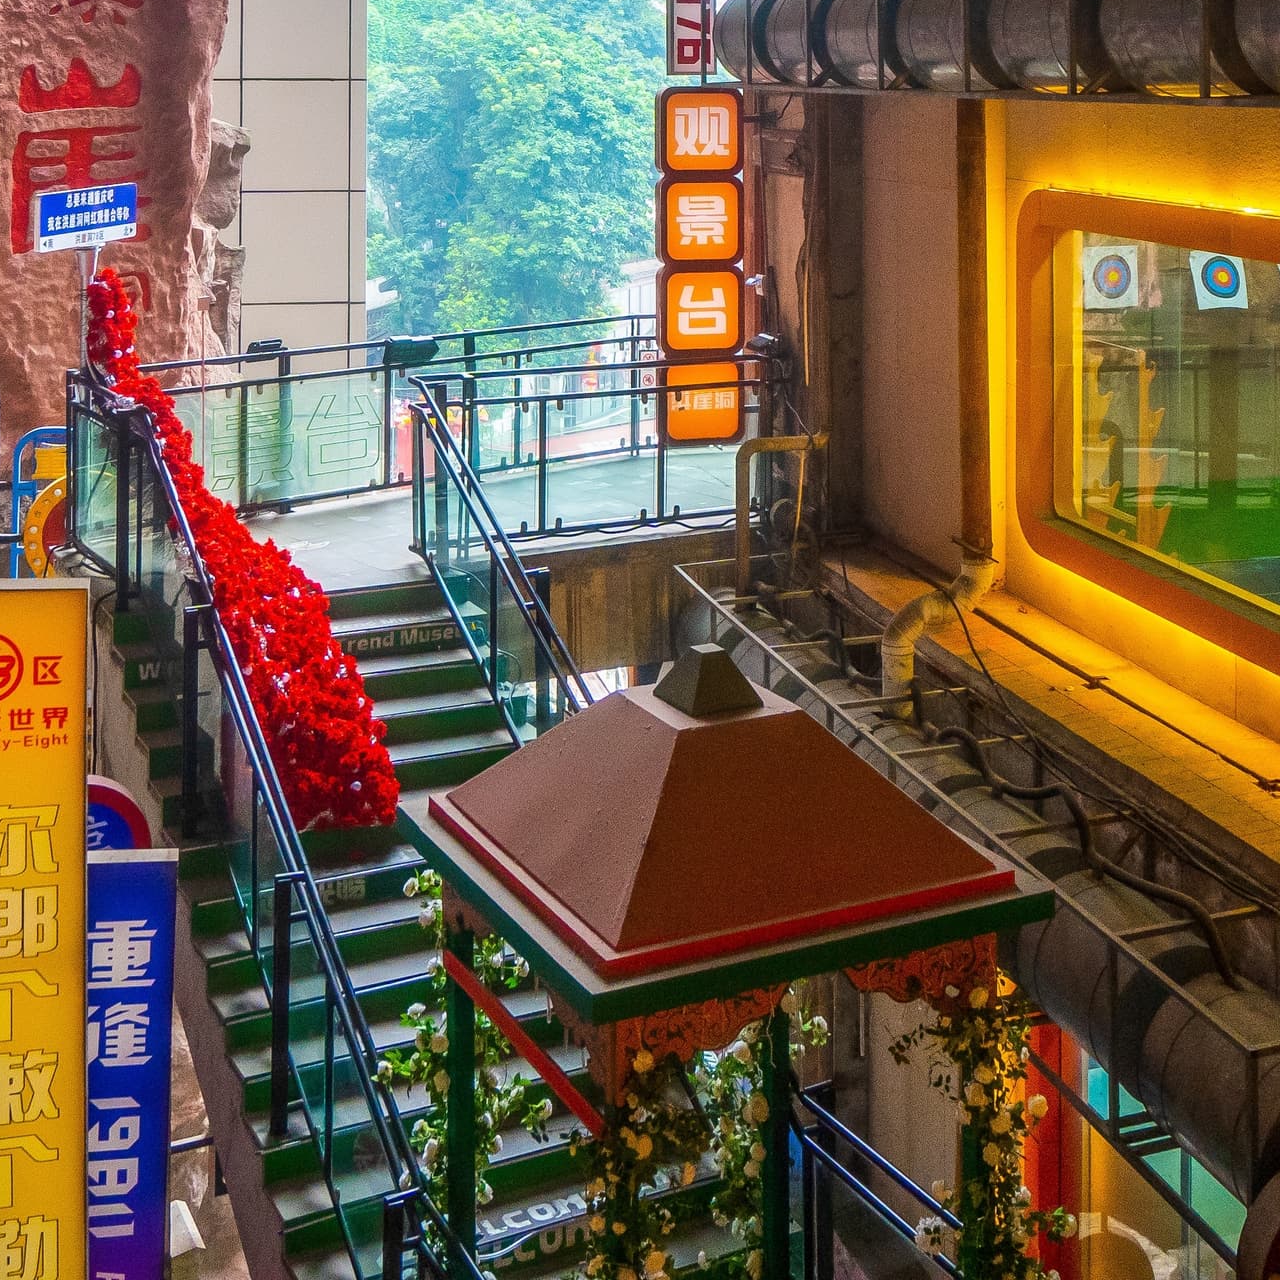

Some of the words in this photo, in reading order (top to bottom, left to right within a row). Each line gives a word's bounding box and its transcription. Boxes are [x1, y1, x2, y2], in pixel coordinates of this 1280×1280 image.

[674, 106, 731, 336] 观景台
[346, 631, 395, 652] rend
